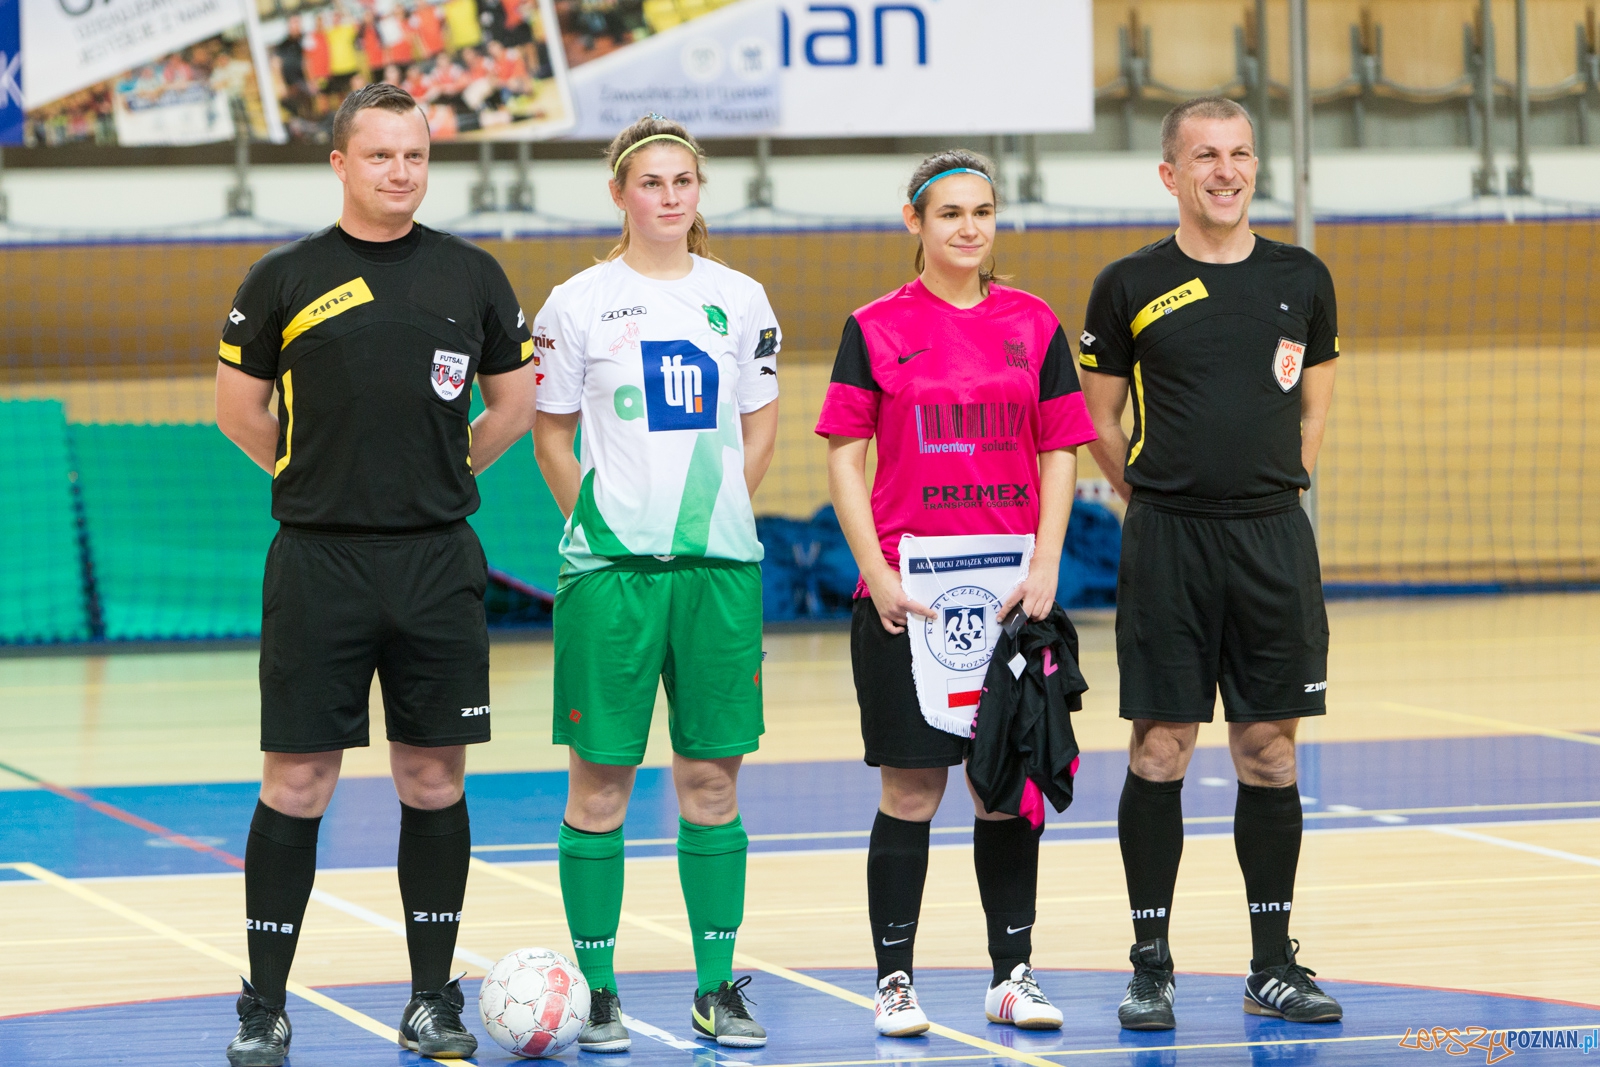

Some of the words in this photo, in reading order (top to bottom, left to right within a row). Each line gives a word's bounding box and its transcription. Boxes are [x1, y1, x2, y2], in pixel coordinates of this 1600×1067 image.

[779, 4, 927, 67] an
[1281, 341, 1303, 355] FUTSAL
[440, 354, 464, 365] FUTSAL
[924, 441, 976, 456] inventory
[922, 483, 1030, 502] PRIMEX
[923, 501, 984, 511] TRANSPORT
[986, 499, 1031, 508] OSOBOWY
[955, 557, 982, 568] ZWIĄZEK
[984, 555, 1016, 565] SPORTOWY
[943, 588, 999, 616] UCZELNIA
[460, 705, 490, 717] zin
[704, 931, 737, 940] zin
